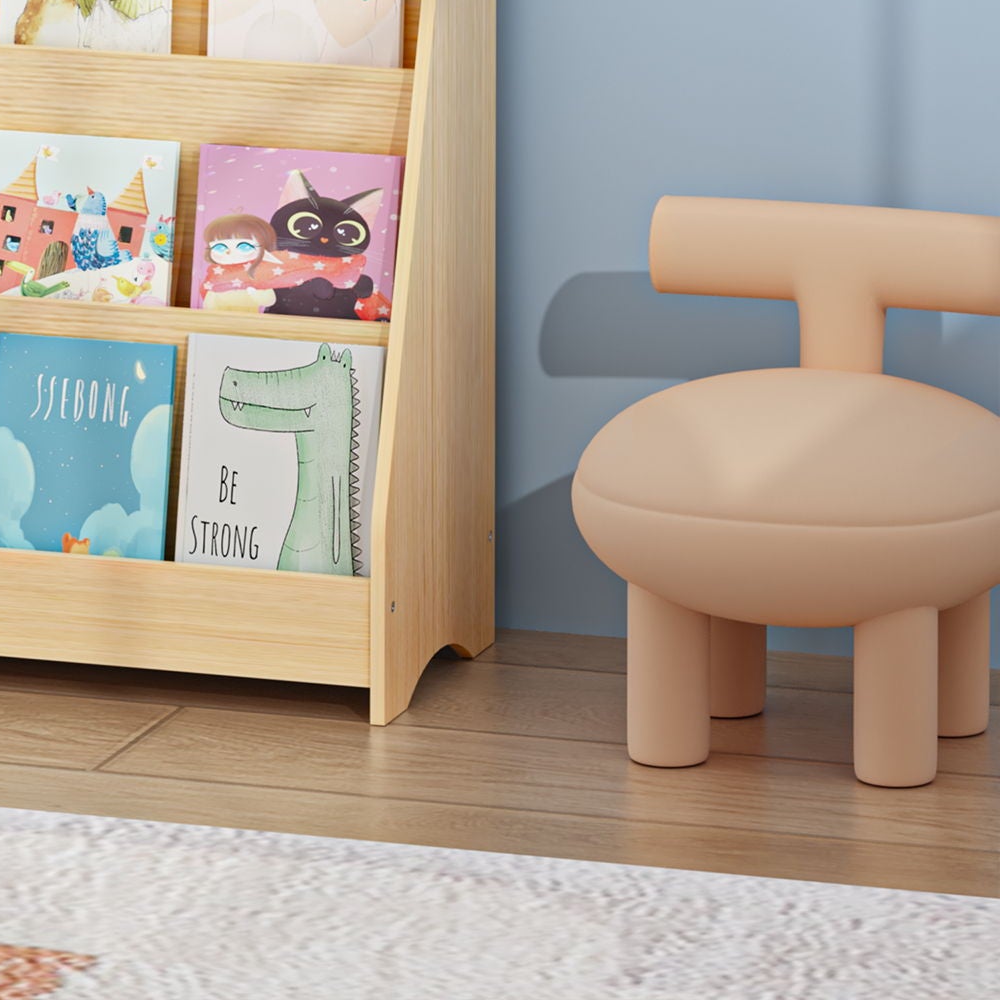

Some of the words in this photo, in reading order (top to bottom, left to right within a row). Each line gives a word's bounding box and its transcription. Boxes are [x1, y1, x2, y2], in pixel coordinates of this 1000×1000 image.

[29, 373, 130, 428] SSEBONG
[219, 465, 238, 505] BE
[189, 515, 259, 560] STRONG
